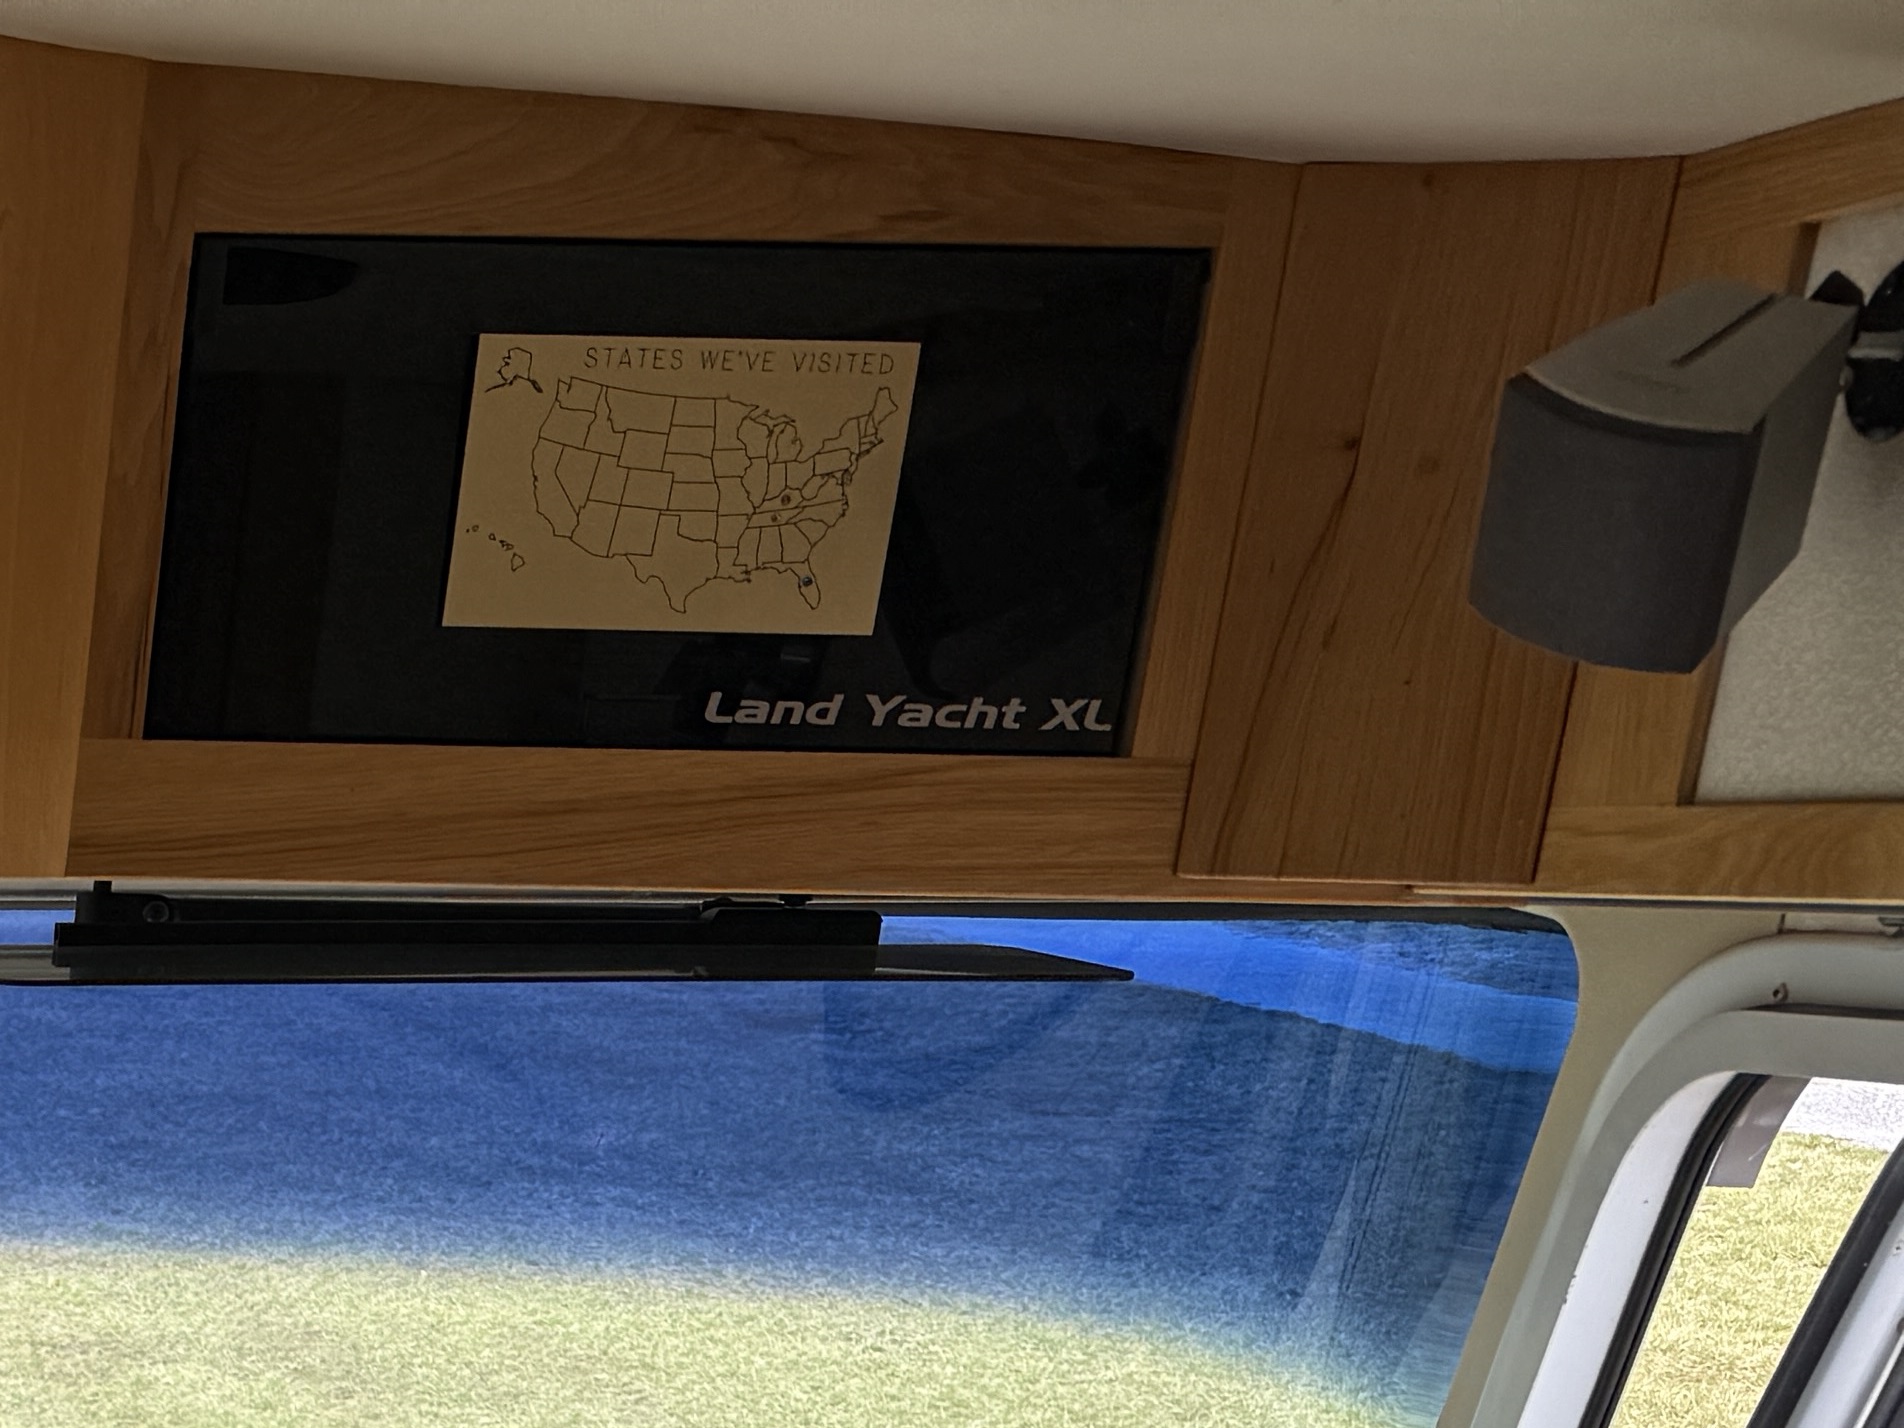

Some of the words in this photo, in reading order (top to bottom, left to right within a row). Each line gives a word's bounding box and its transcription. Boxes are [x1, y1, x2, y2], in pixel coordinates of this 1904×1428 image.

[582, 346, 685, 371] STATES
[699, 349, 776, 374] WE'VE
[791, 351, 897, 377] VISITED
[703, 690, 844, 728] Land
[865, 693, 1027, 731] Yacht
[1038, 697, 1114, 733] XL
